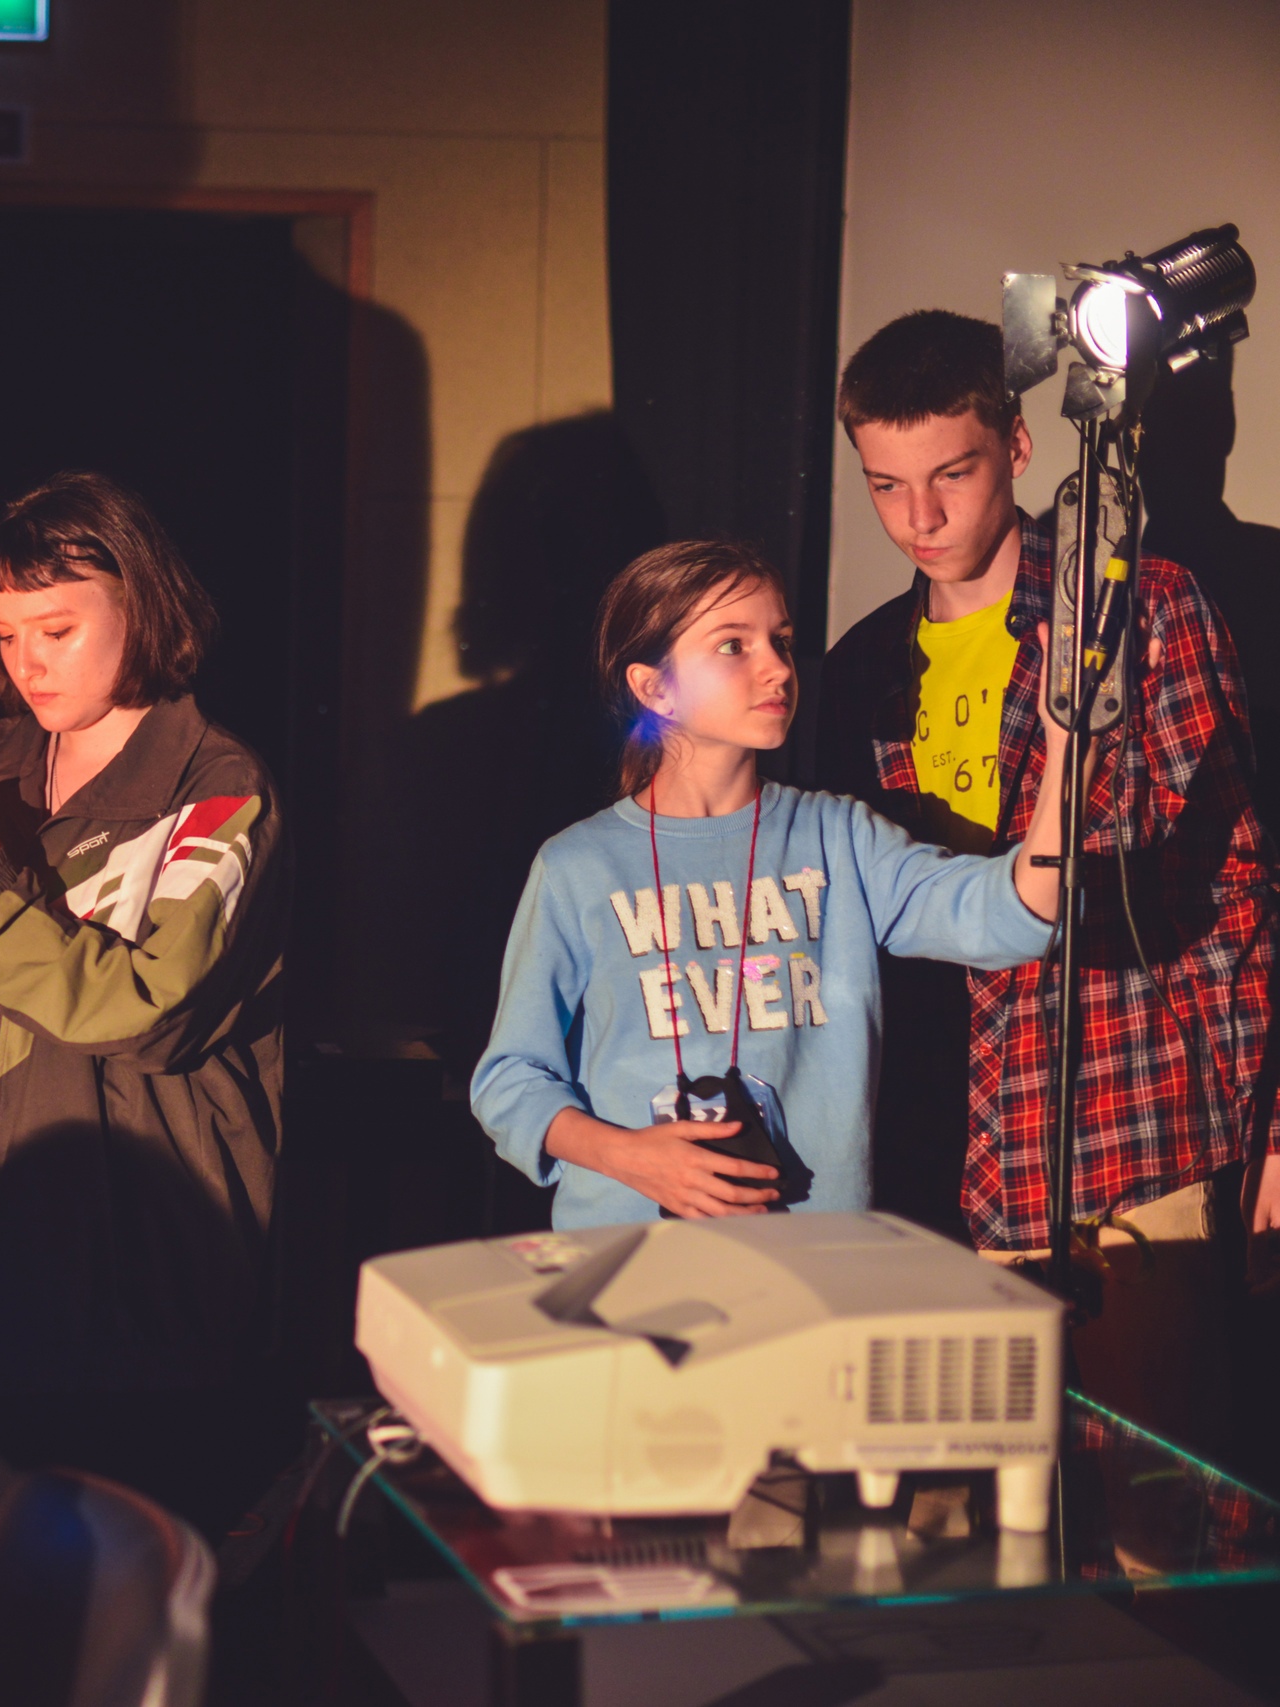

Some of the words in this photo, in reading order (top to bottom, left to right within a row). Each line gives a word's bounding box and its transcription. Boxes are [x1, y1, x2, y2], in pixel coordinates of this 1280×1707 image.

[932, 751, 956, 768] EST.
[610, 868, 828, 958] WHAT
[639, 953, 829, 1040] EVER
